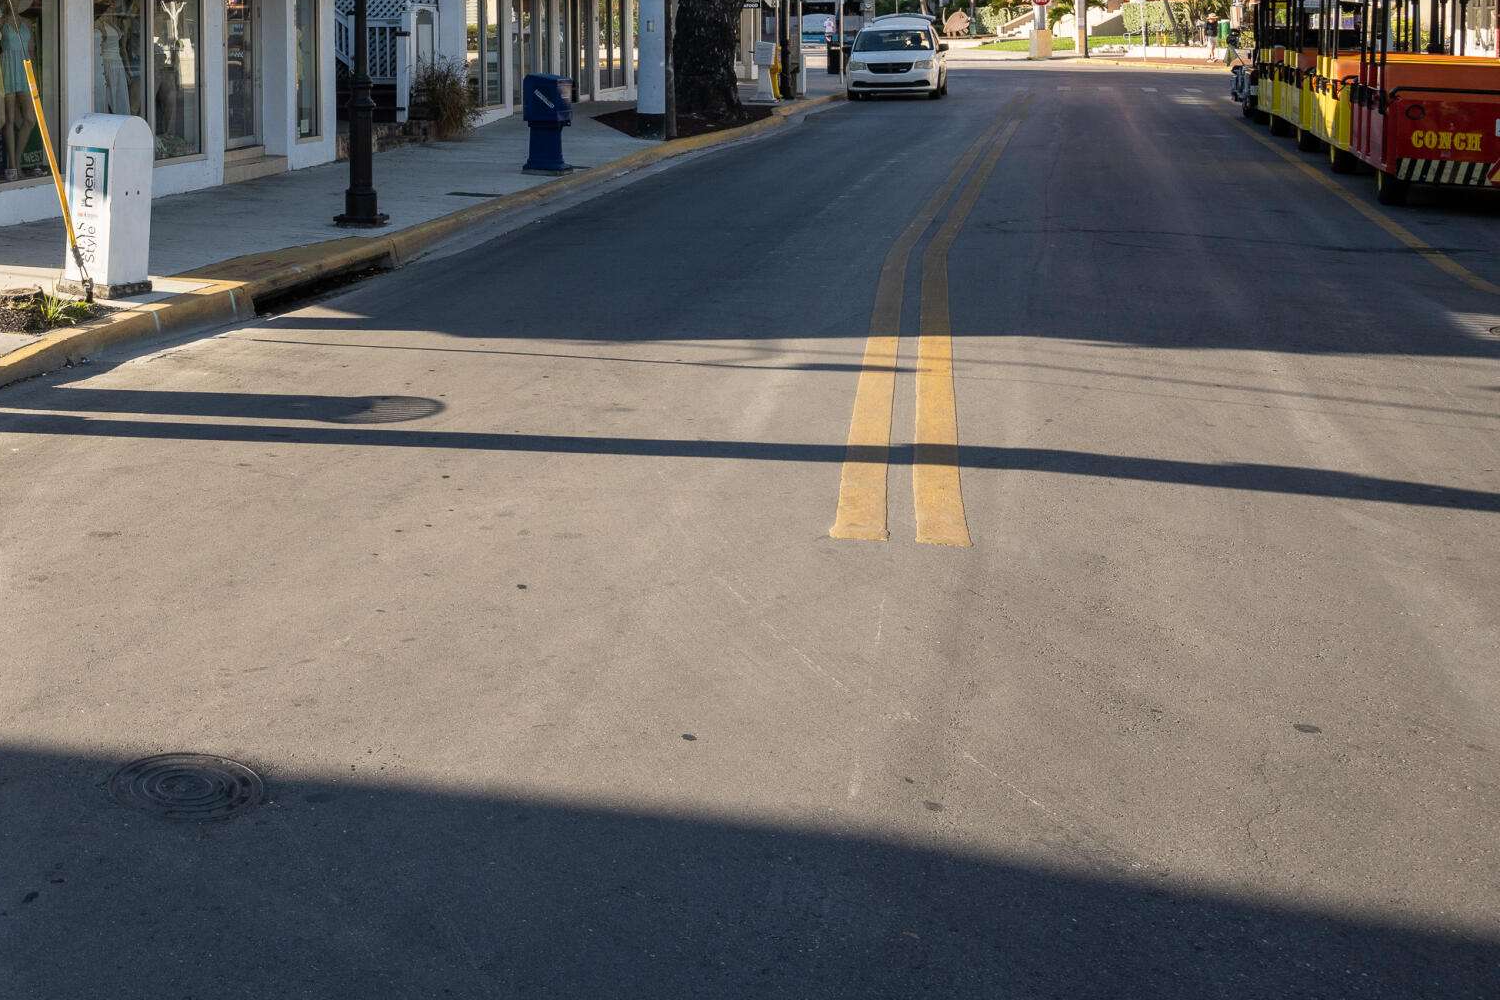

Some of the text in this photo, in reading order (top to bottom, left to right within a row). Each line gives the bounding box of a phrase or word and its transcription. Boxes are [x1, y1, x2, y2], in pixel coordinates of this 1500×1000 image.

[1411, 129, 1482, 151] CONCH
[83, 155, 95, 208] menu
[85, 226, 98, 263] Style
